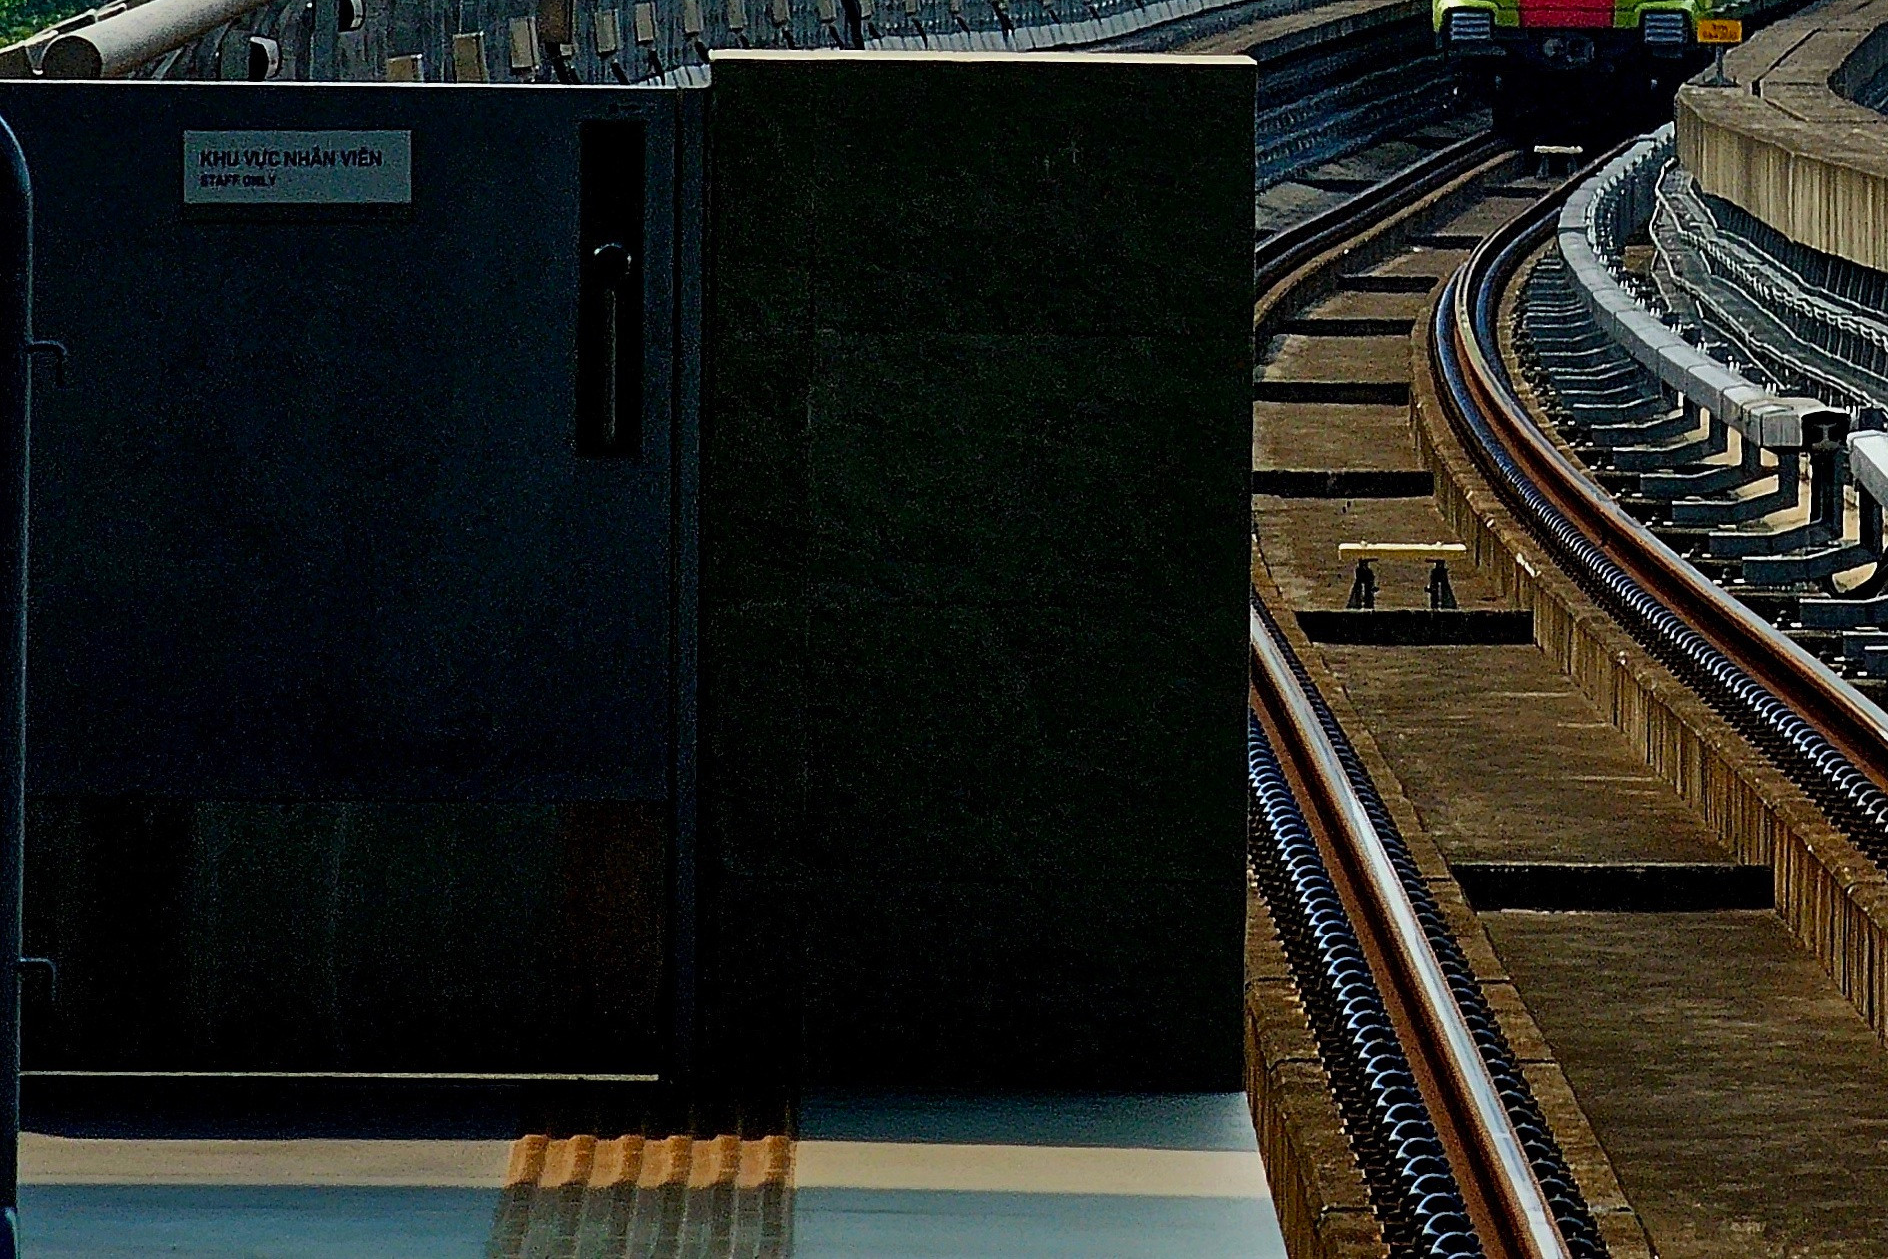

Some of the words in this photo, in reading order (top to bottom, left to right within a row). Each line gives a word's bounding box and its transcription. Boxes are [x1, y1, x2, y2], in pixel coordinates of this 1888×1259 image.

[200, 149, 240, 167] KHU
[243, 148, 281, 170] VỰC
[283, 145, 337, 167] NHÂN
[340, 147, 383, 167] VIÊN
[200, 174, 240, 187] STAFF
[242, 173, 277, 187] ONLY
